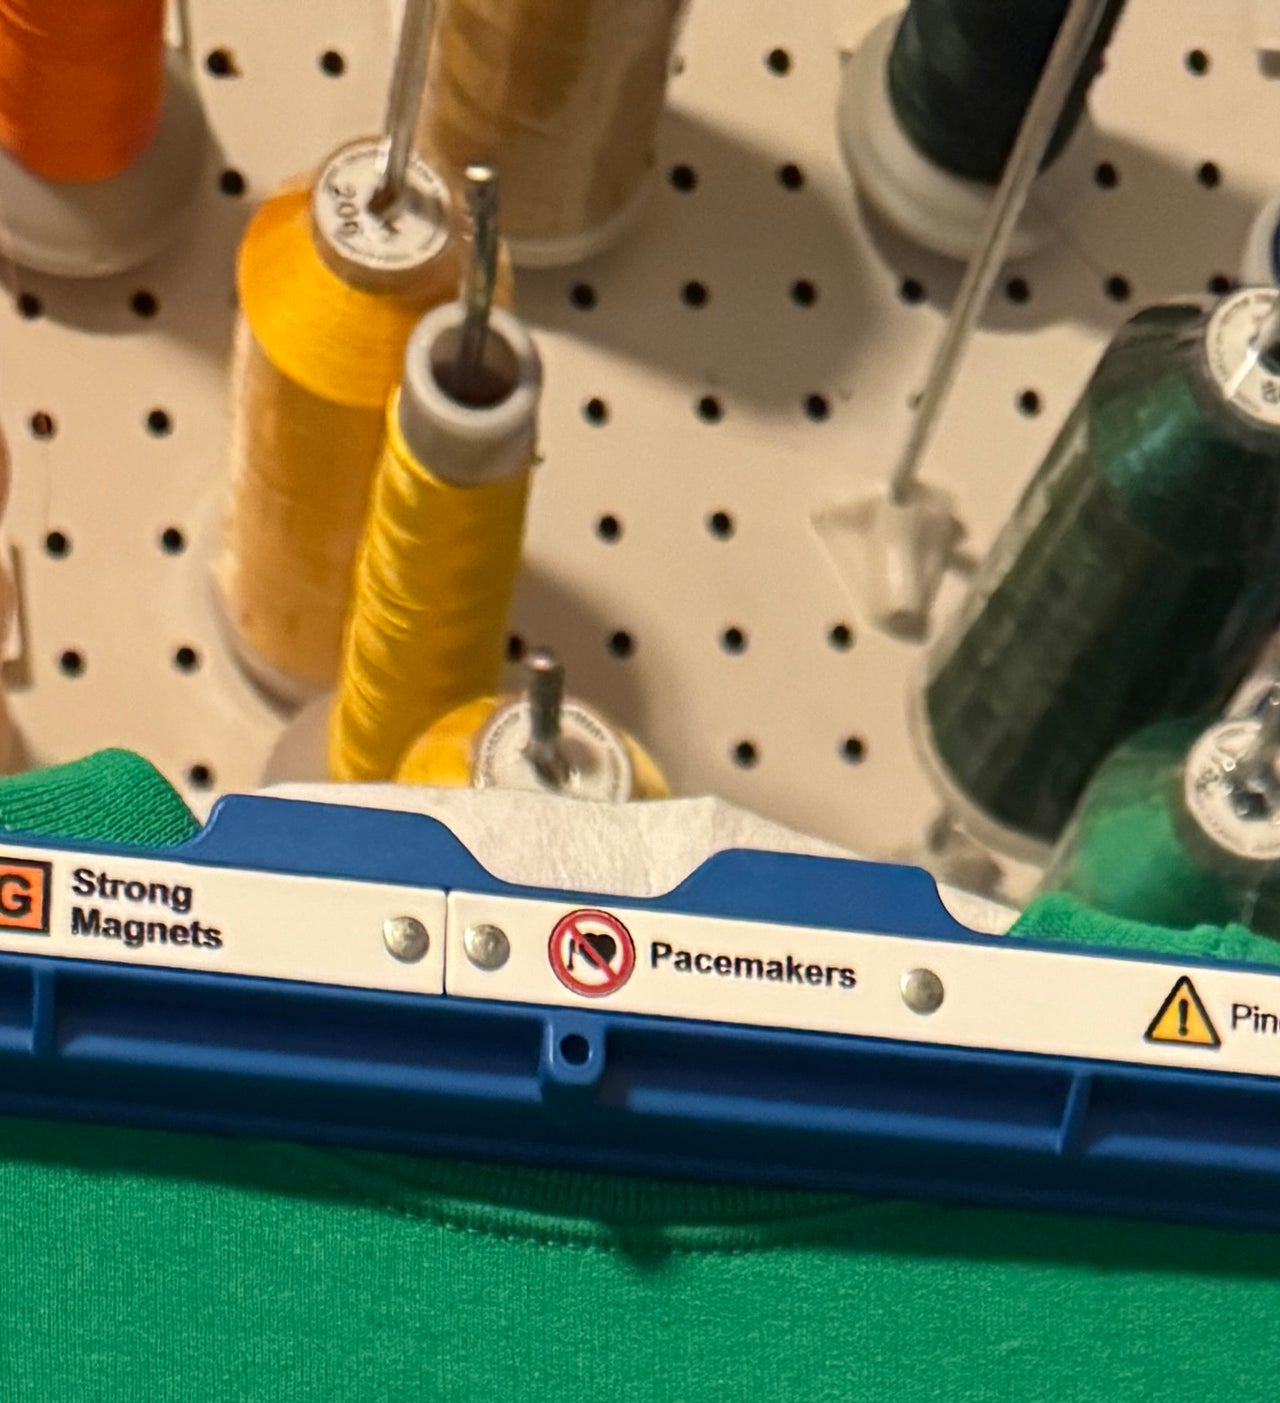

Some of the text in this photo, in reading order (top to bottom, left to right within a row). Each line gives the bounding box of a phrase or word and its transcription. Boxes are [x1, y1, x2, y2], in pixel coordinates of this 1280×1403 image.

[71, 867, 194, 914] Strong
[71, 906, 224, 950] Magnets
[650, 941, 858, 989] Pacemakers
